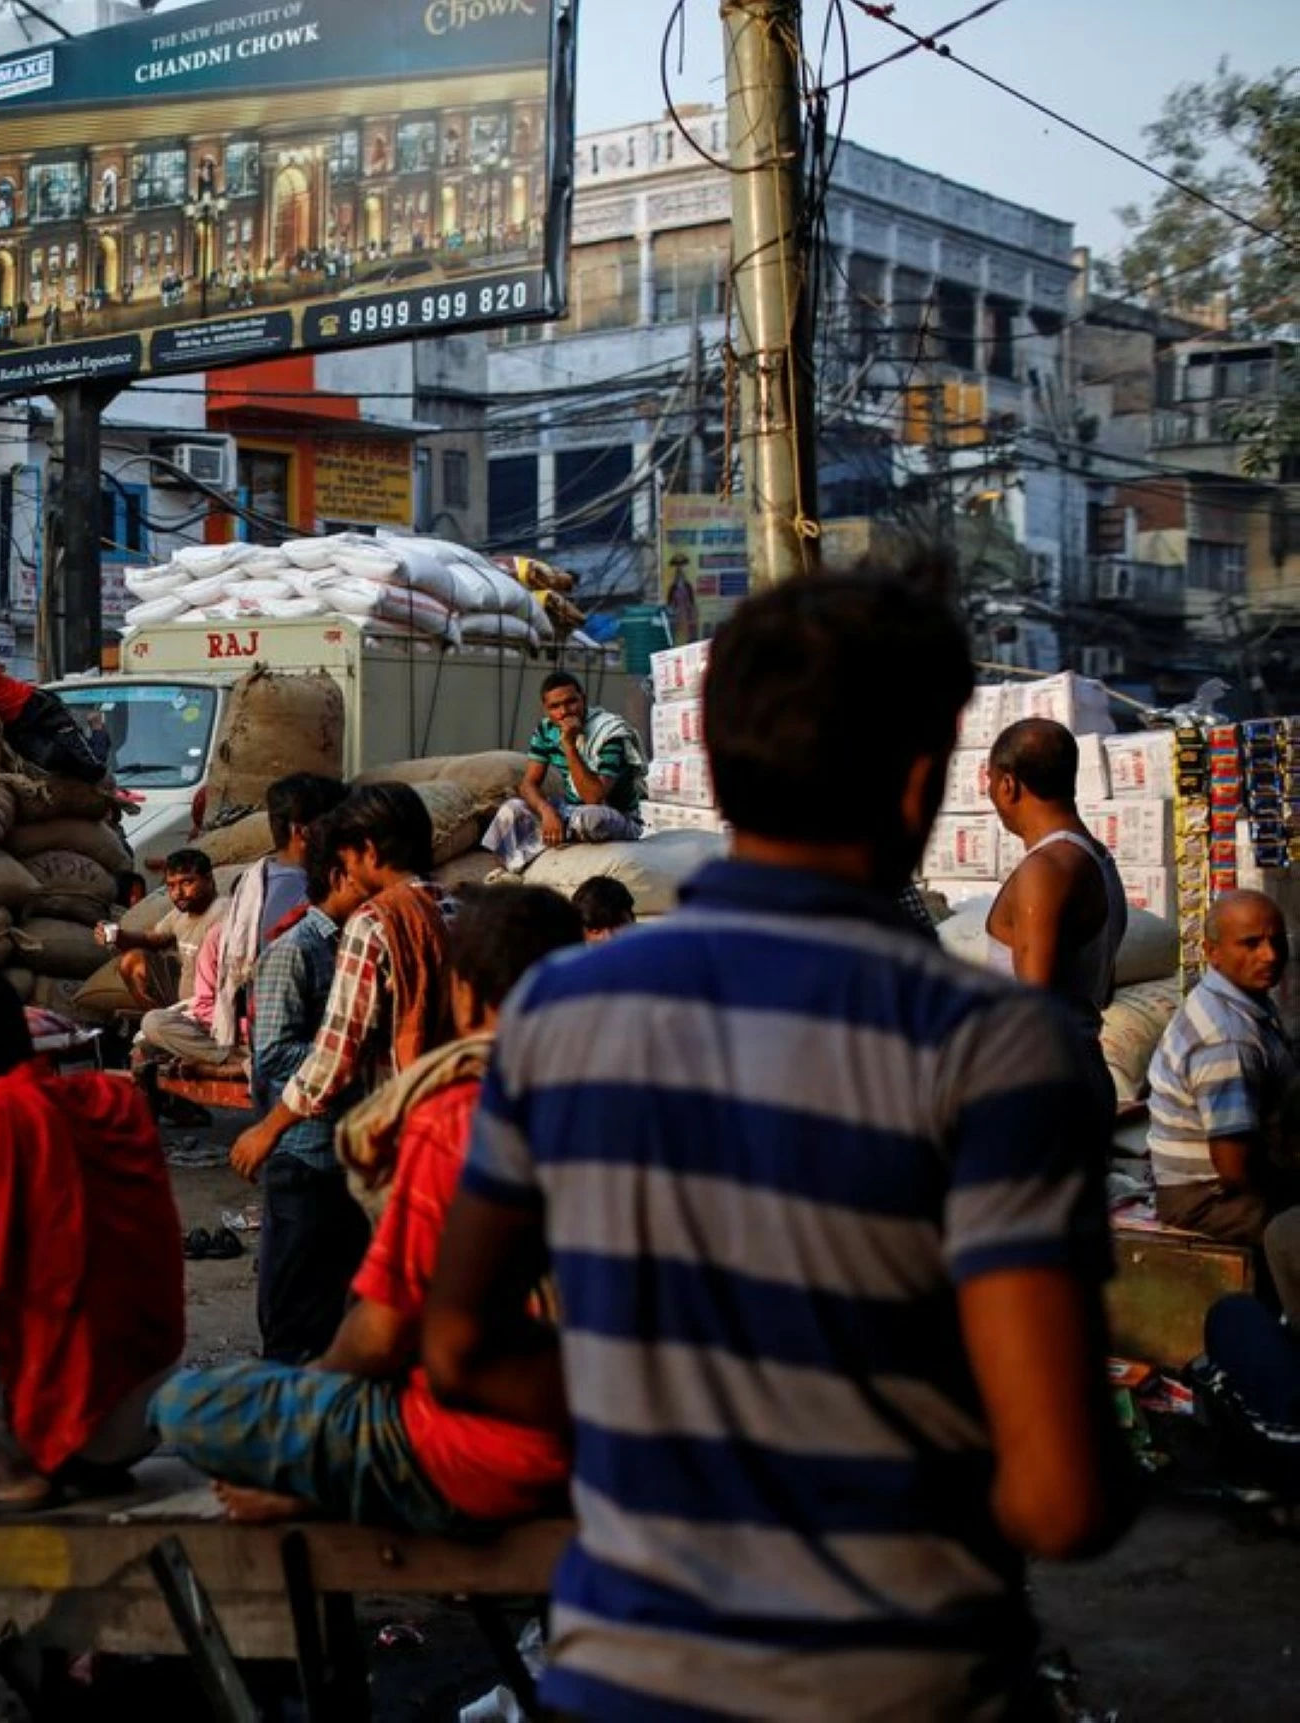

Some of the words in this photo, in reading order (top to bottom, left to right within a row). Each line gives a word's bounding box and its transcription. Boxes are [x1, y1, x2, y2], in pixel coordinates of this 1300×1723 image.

[152, 36, 180, 52] THE
[182, 26, 212, 44] NEW
[215, 10, 278, 36] IDENTITY
[281, 3, 303, 19] OF
[134, 41, 232, 84] CHANDNI
[236, 23, 321, 59] CHOWK
[349, 300, 411, 333] 9999
[421, 291, 468, 322] 999
[478, 281, 527, 314] 820
[35, 357, 81, 375] Wholesale
[82, 353, 132, 373] Experience
[206, 630, 260, 659] RAJ
